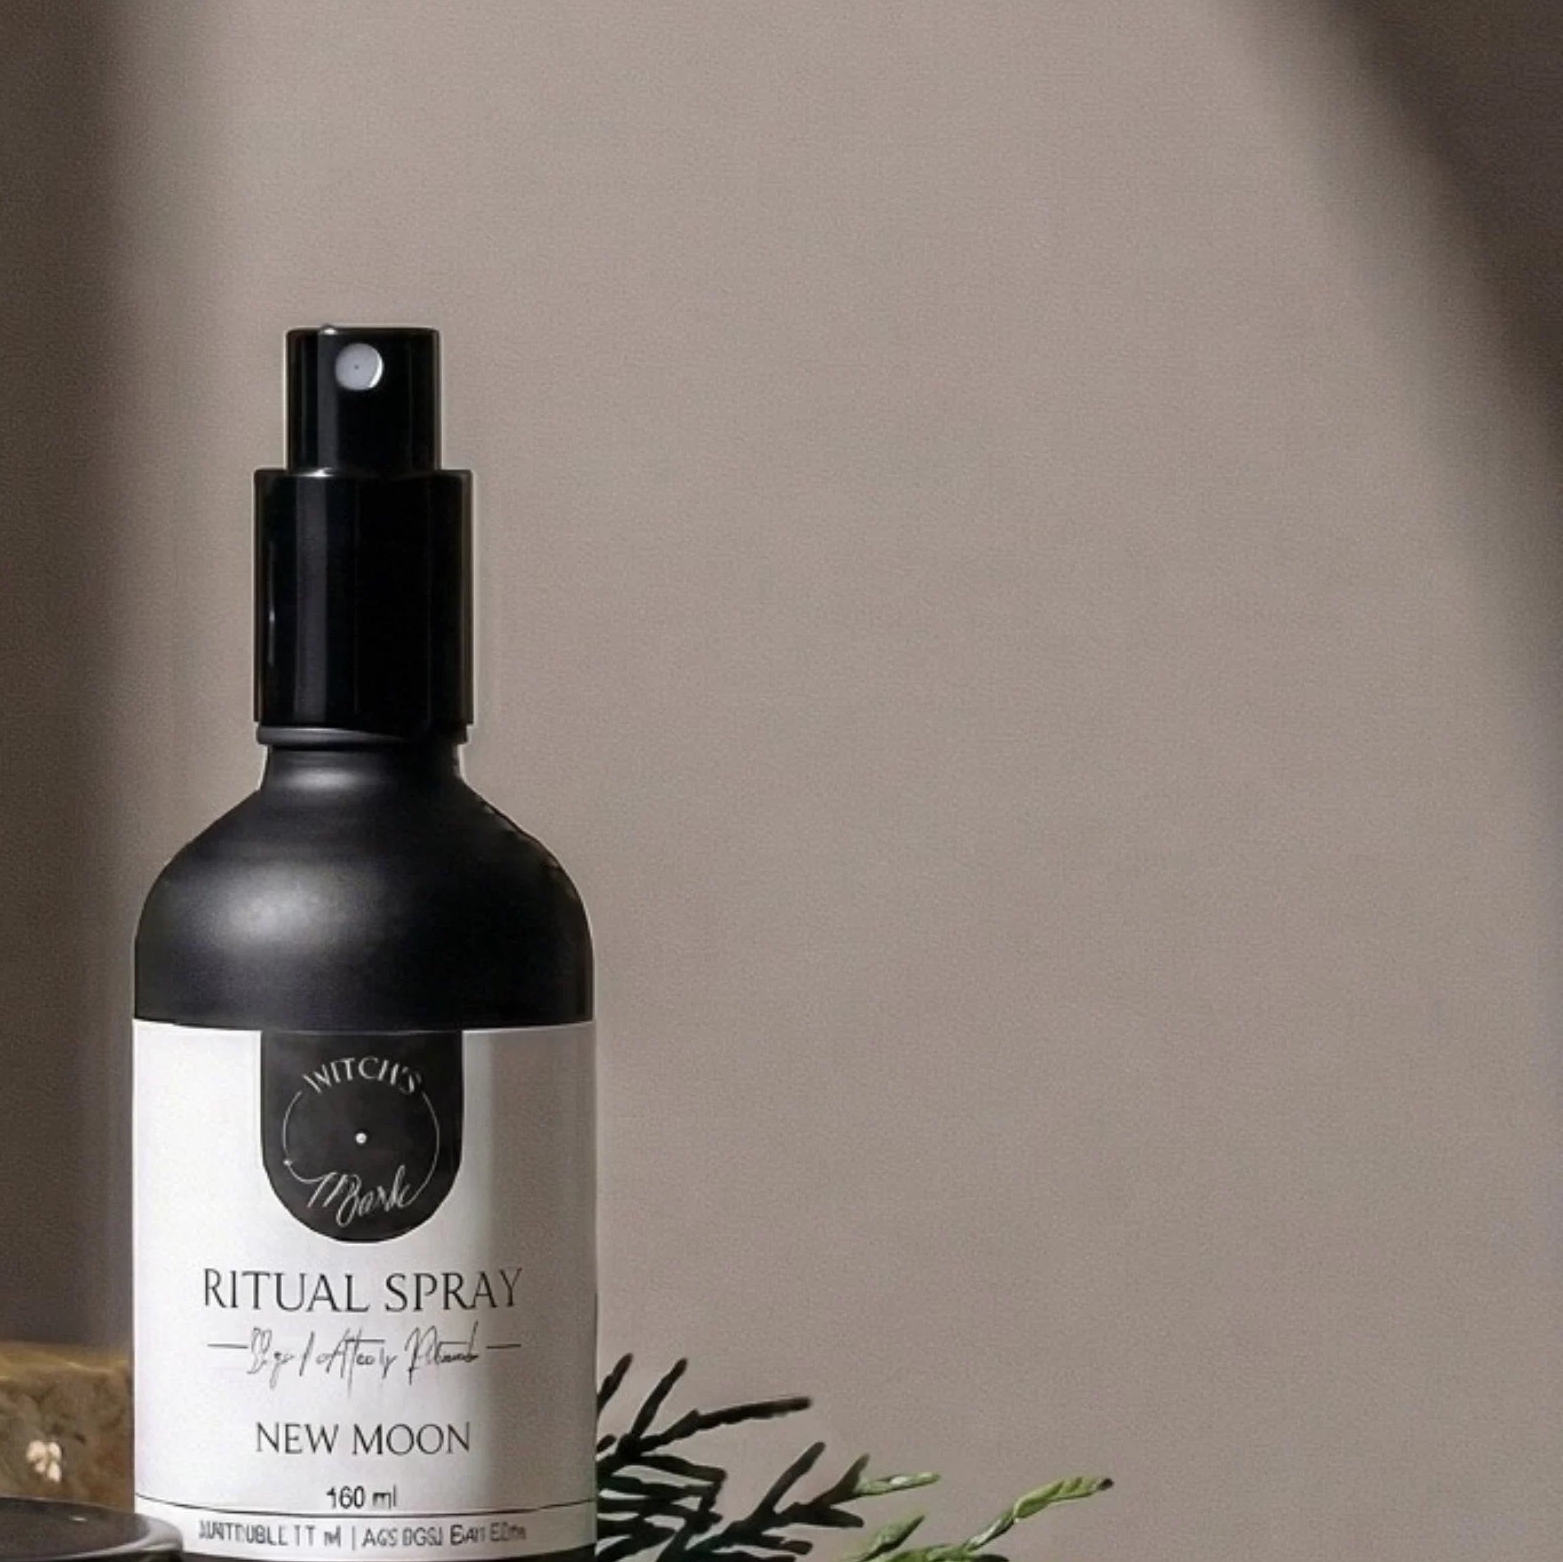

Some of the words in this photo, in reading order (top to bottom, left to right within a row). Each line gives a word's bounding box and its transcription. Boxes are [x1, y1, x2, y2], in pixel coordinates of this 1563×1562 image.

[203, 1268, 369, 1312] RITUAL
[384, 1268, 524, 1312] SPRAY
[255, 1422, 340, 1455] NEW
[351, 1422, 472, 1455] MOON
[326, 1485, 366, 1509] 160
[372, 1484, 398, 1509] ml
